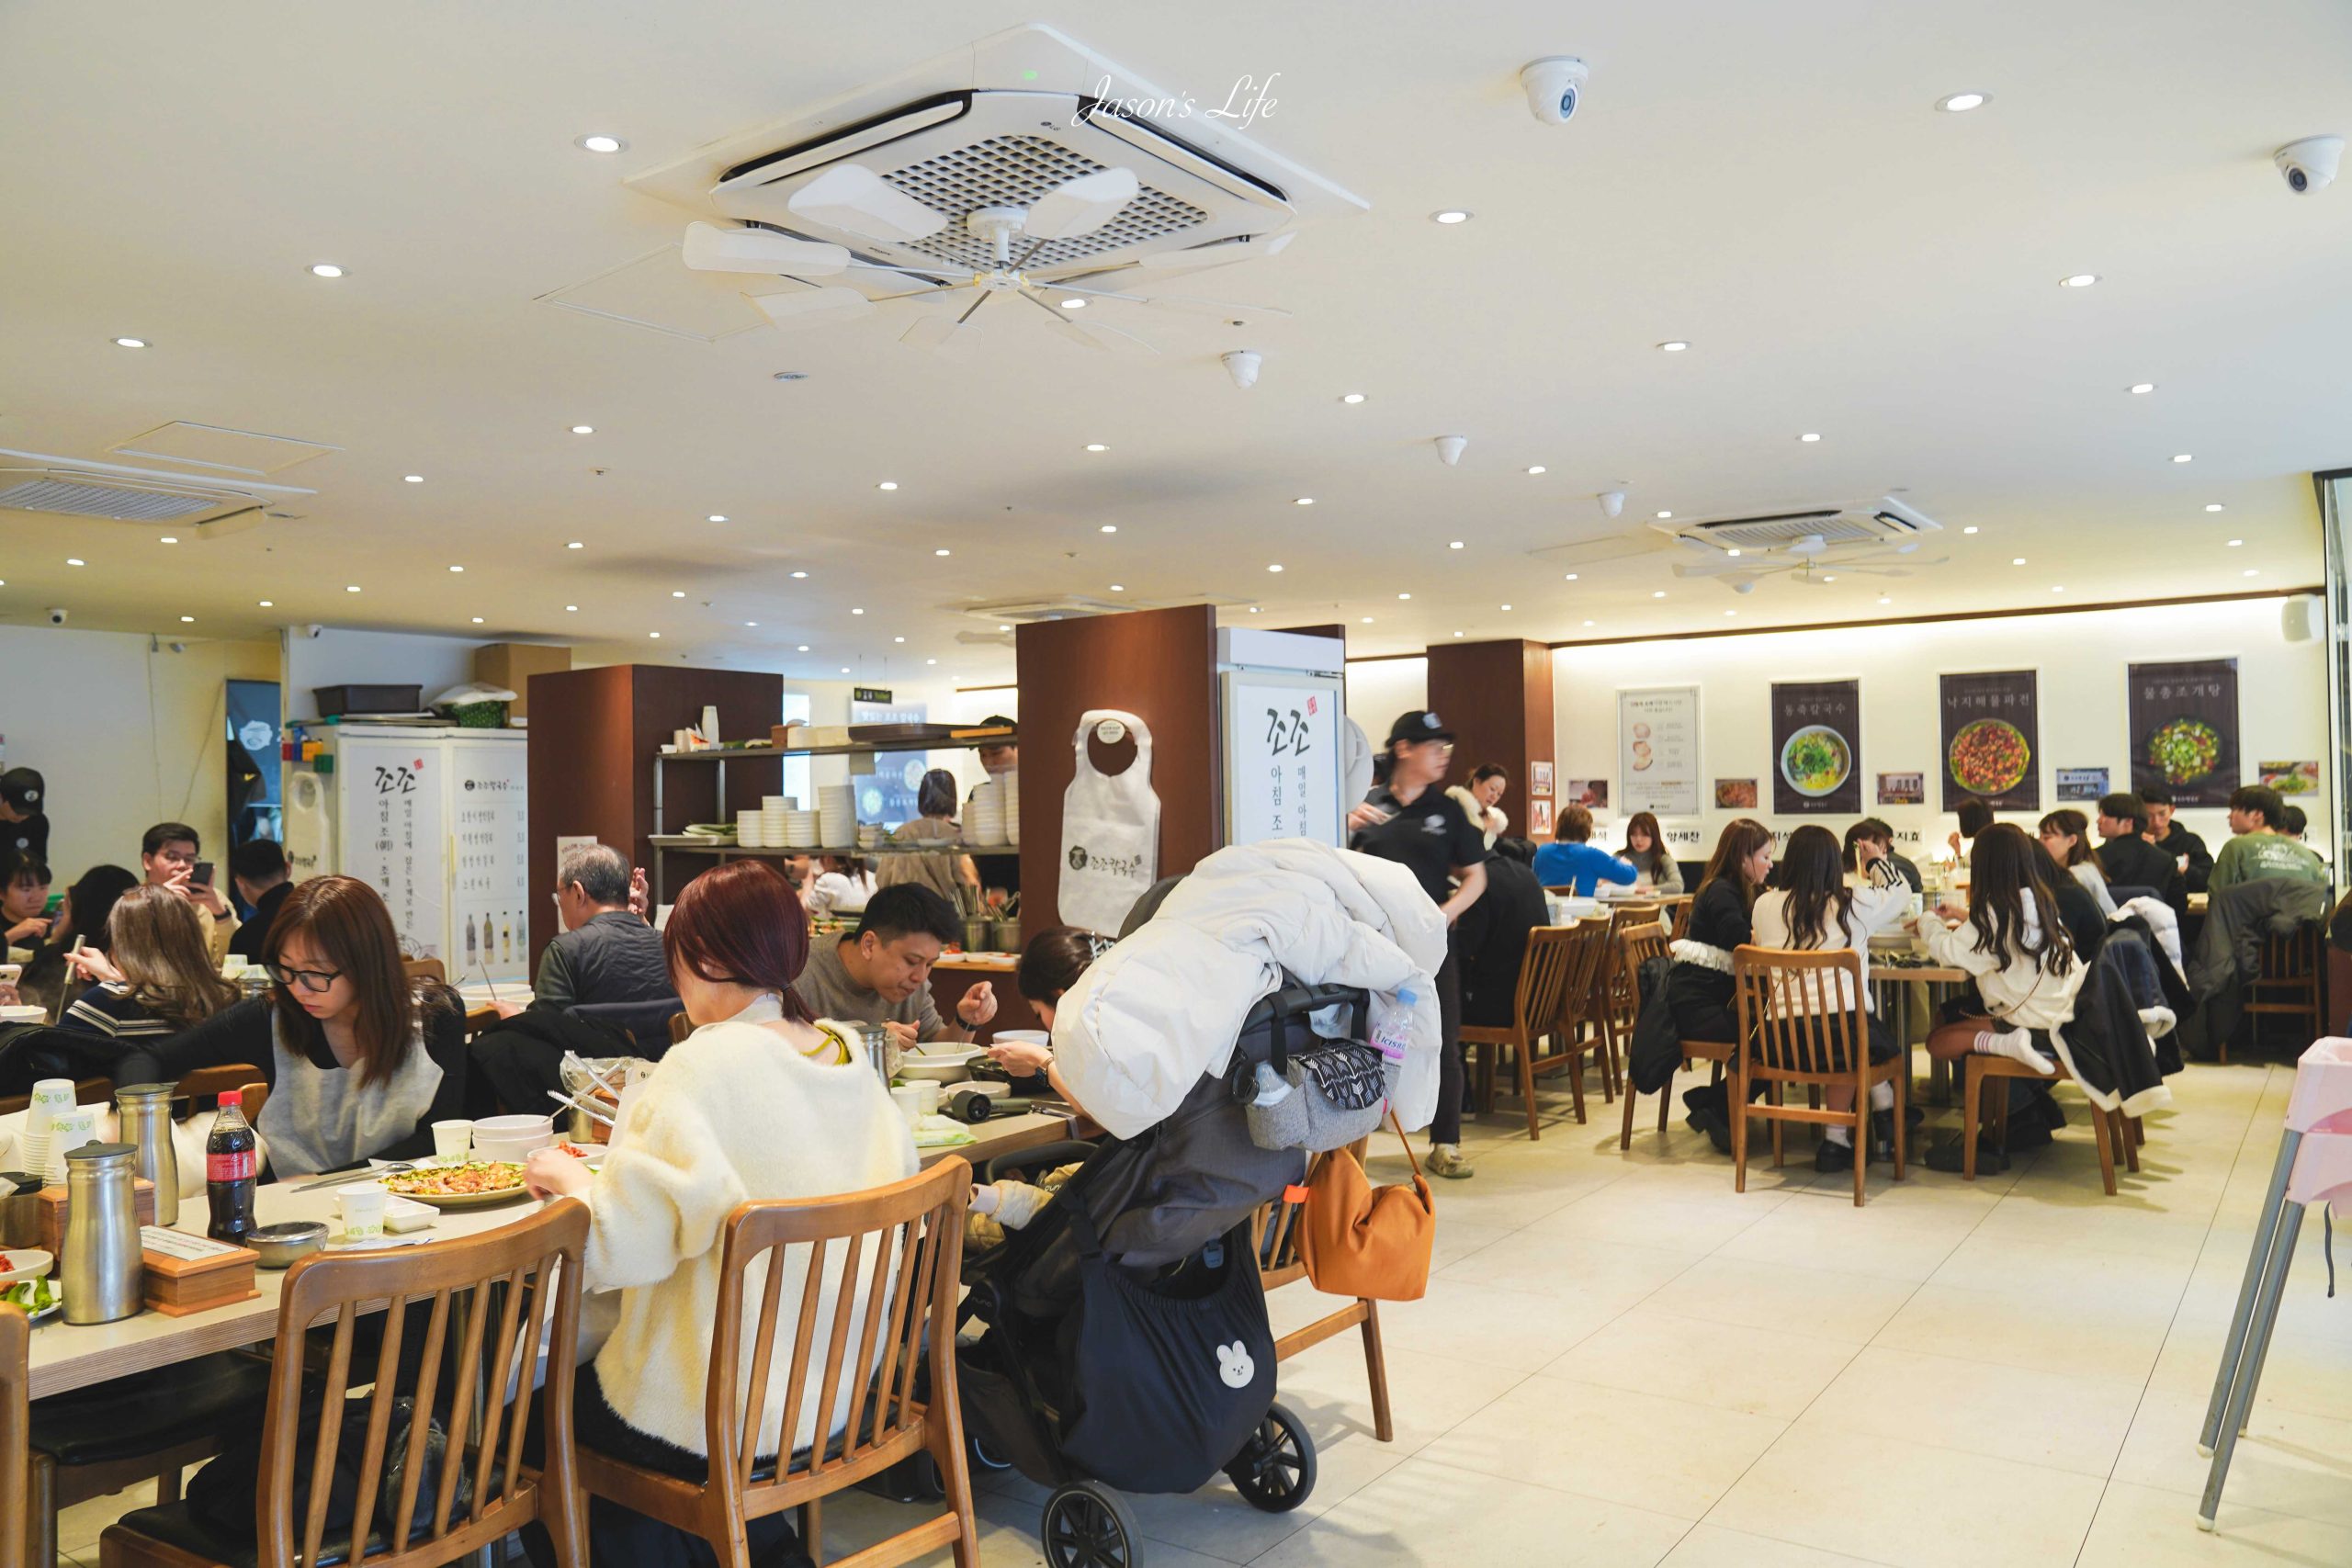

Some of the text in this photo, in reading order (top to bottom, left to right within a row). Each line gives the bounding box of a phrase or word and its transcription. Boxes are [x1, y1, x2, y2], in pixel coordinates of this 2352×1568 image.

[1947, 692, 2030, 709] 낙지해물파전
[1267, 707, 1310, 757] 조조
[375, 766, 416, 795] 조조
[1271, 764, 1283, 807] 아침
[1297, 765, 1307, 797] 매일
[378, 798, 389, 823] 아침
[1667, 830, 1701, 844] 양세찬
[1091, 856, 1136, 879] 조조칼국수
